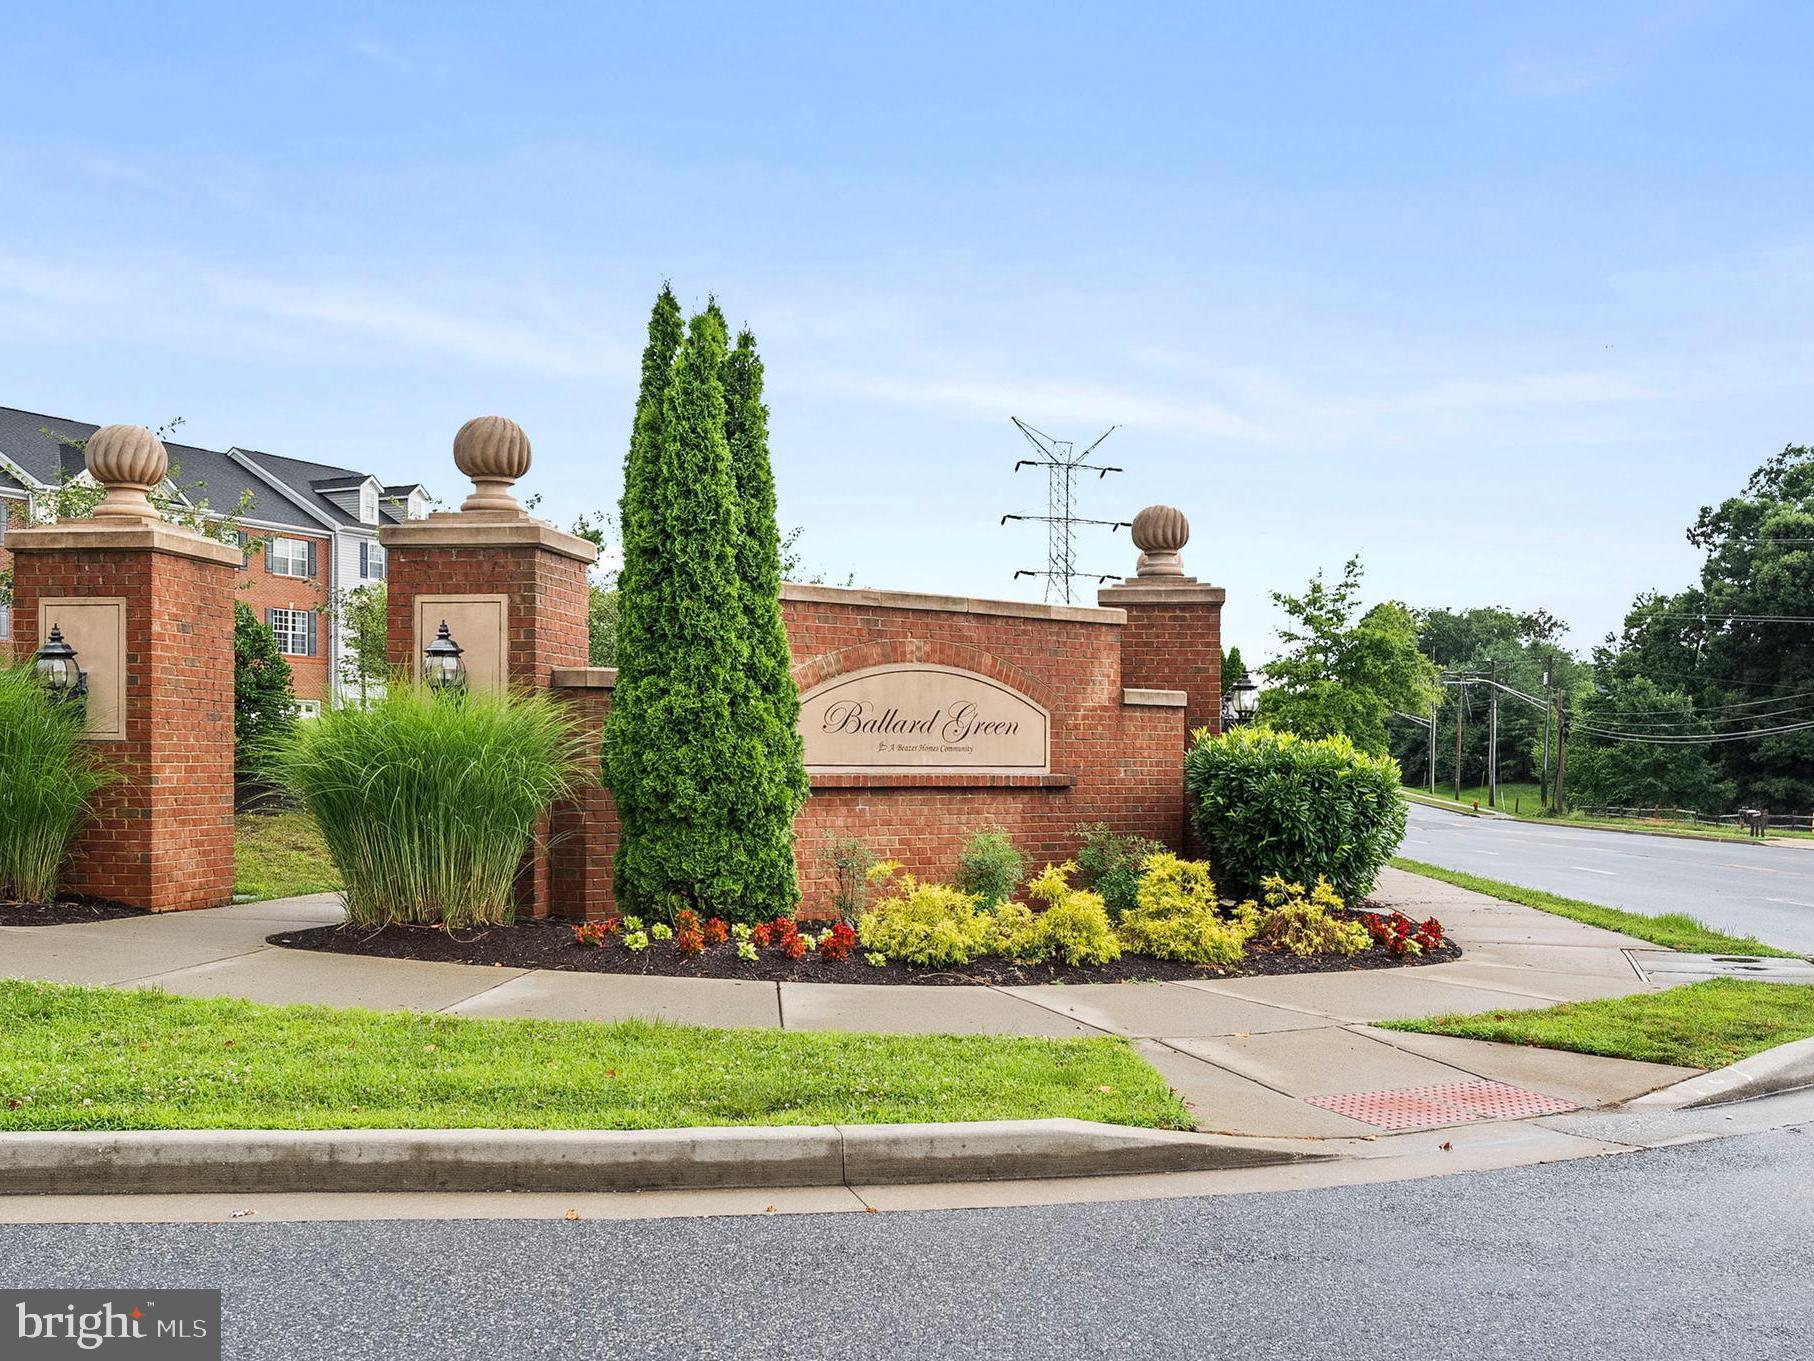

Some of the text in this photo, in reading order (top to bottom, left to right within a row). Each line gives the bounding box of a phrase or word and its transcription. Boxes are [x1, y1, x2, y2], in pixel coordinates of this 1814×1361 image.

[822, 700, 1020, 743] Ballard Green
[888, 743, 973, 754] A Beazer Homes Community
